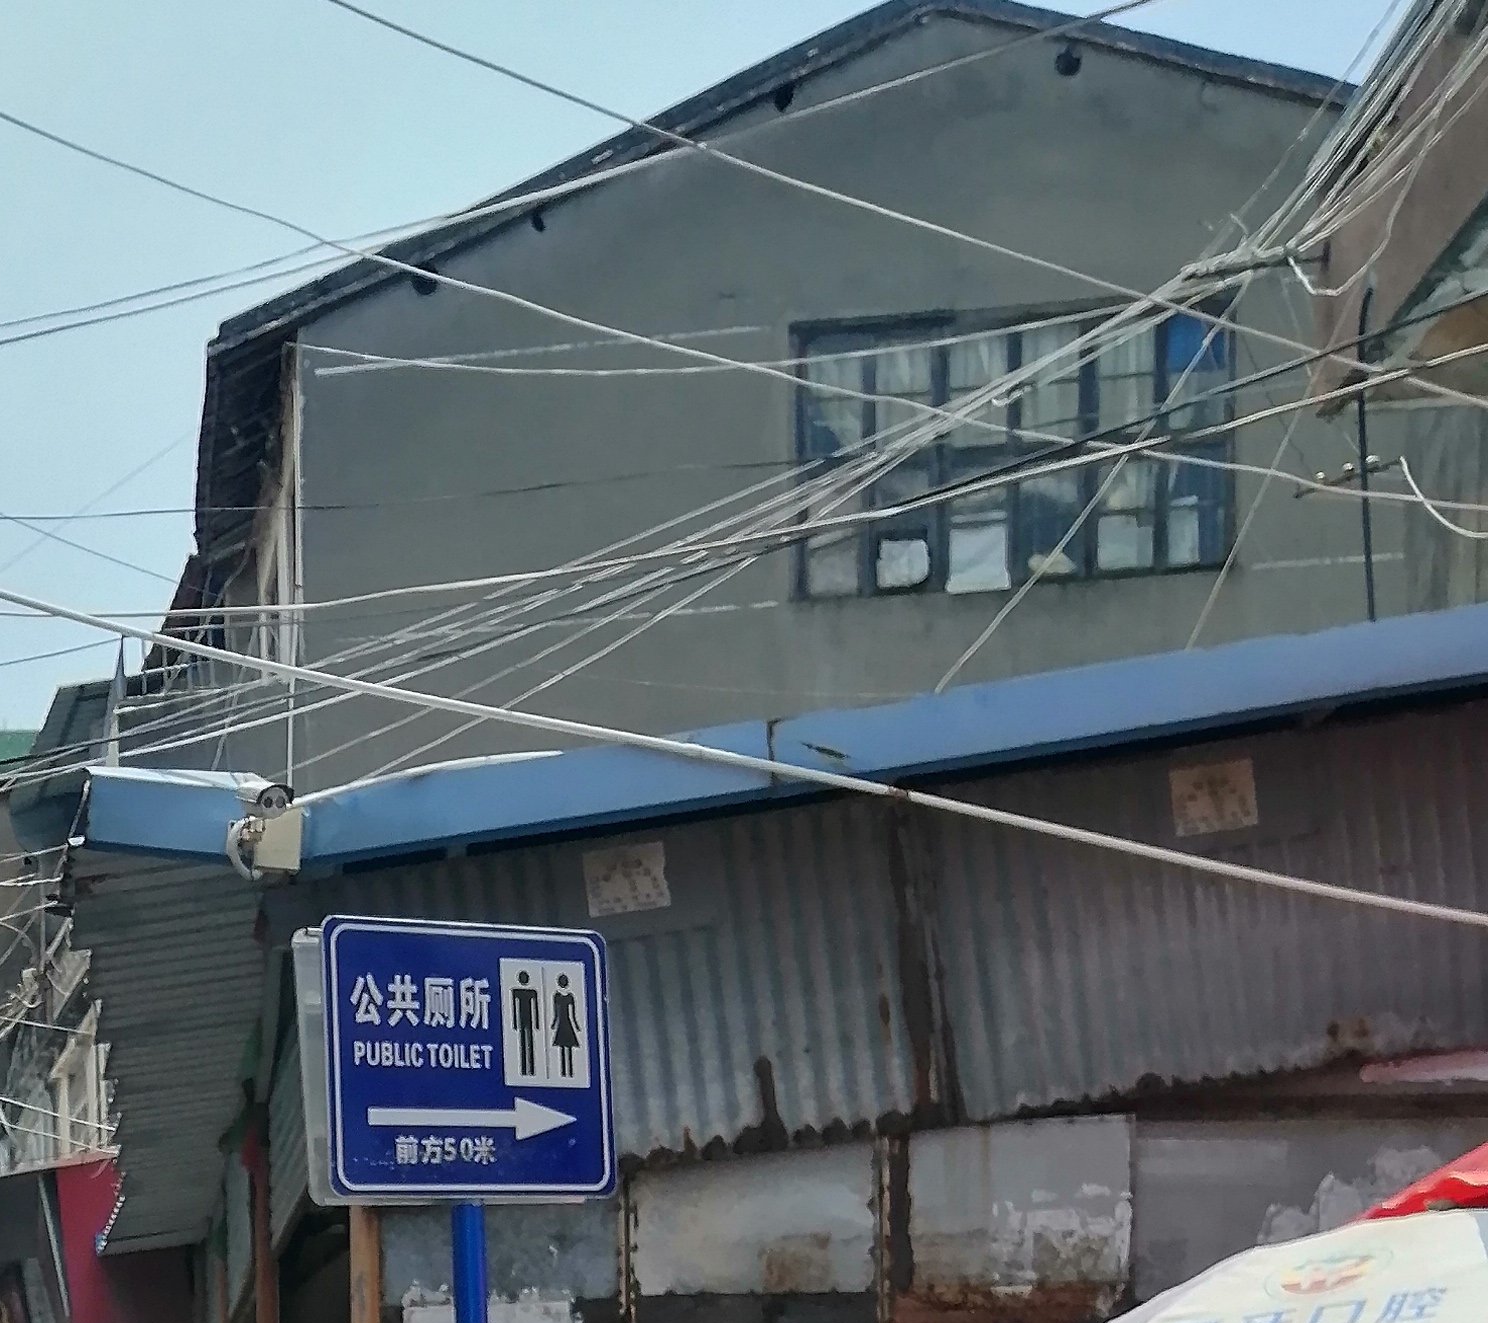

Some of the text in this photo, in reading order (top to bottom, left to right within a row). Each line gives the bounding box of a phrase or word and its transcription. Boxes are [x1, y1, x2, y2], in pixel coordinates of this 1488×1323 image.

[349, 972, 491, 1030] 公共厕所
[353, 1040, 494, 1070] PUBLIC TOILET
[394, 1135, 497, 1166] 前方50米
